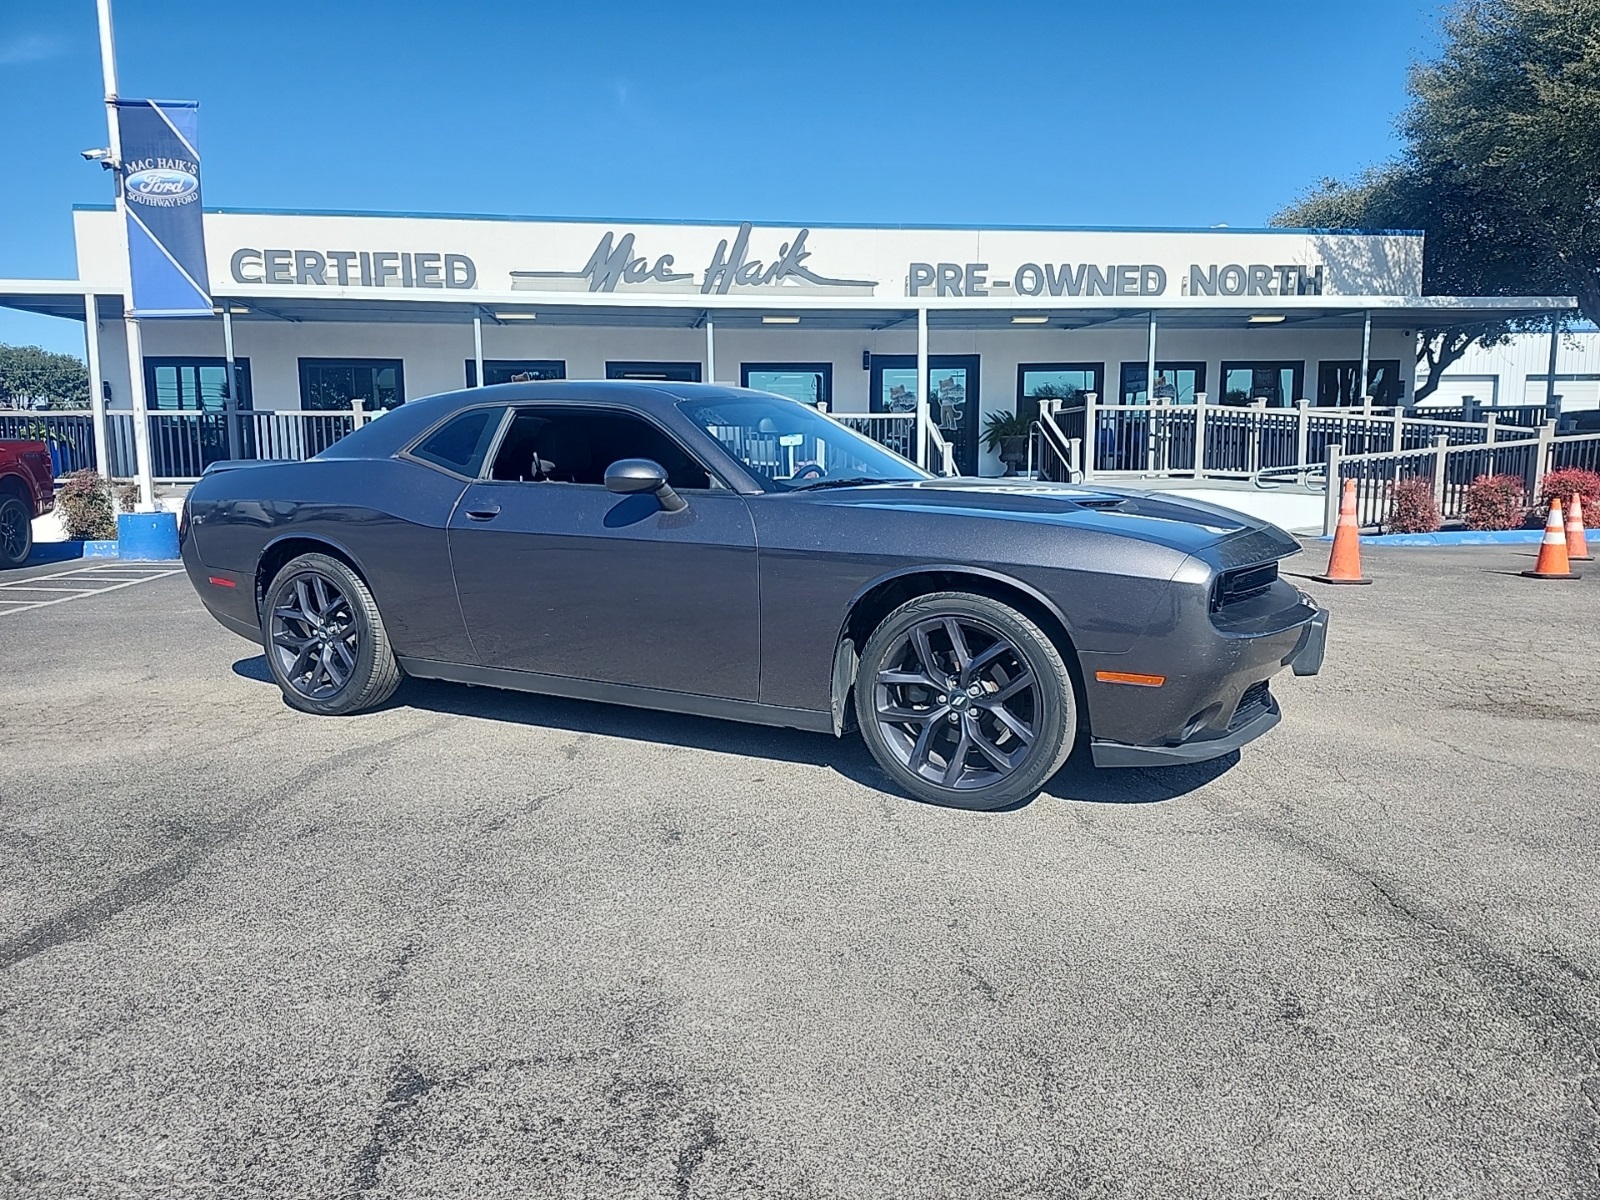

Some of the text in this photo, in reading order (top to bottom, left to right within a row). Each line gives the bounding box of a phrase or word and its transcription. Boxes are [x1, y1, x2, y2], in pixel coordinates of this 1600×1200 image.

[125, 157, 198, 175] MAC HAIK'S
[140, 174, 185, 194] Ford
[127, 191, 199, 207] SOUTHWAY FORD
[230, 247, 478, 290] CERTIFIED
[510, 221, 880, 295] Mac Haik
[907, 262, 1324, 298] PRE-OWNED NORTH
